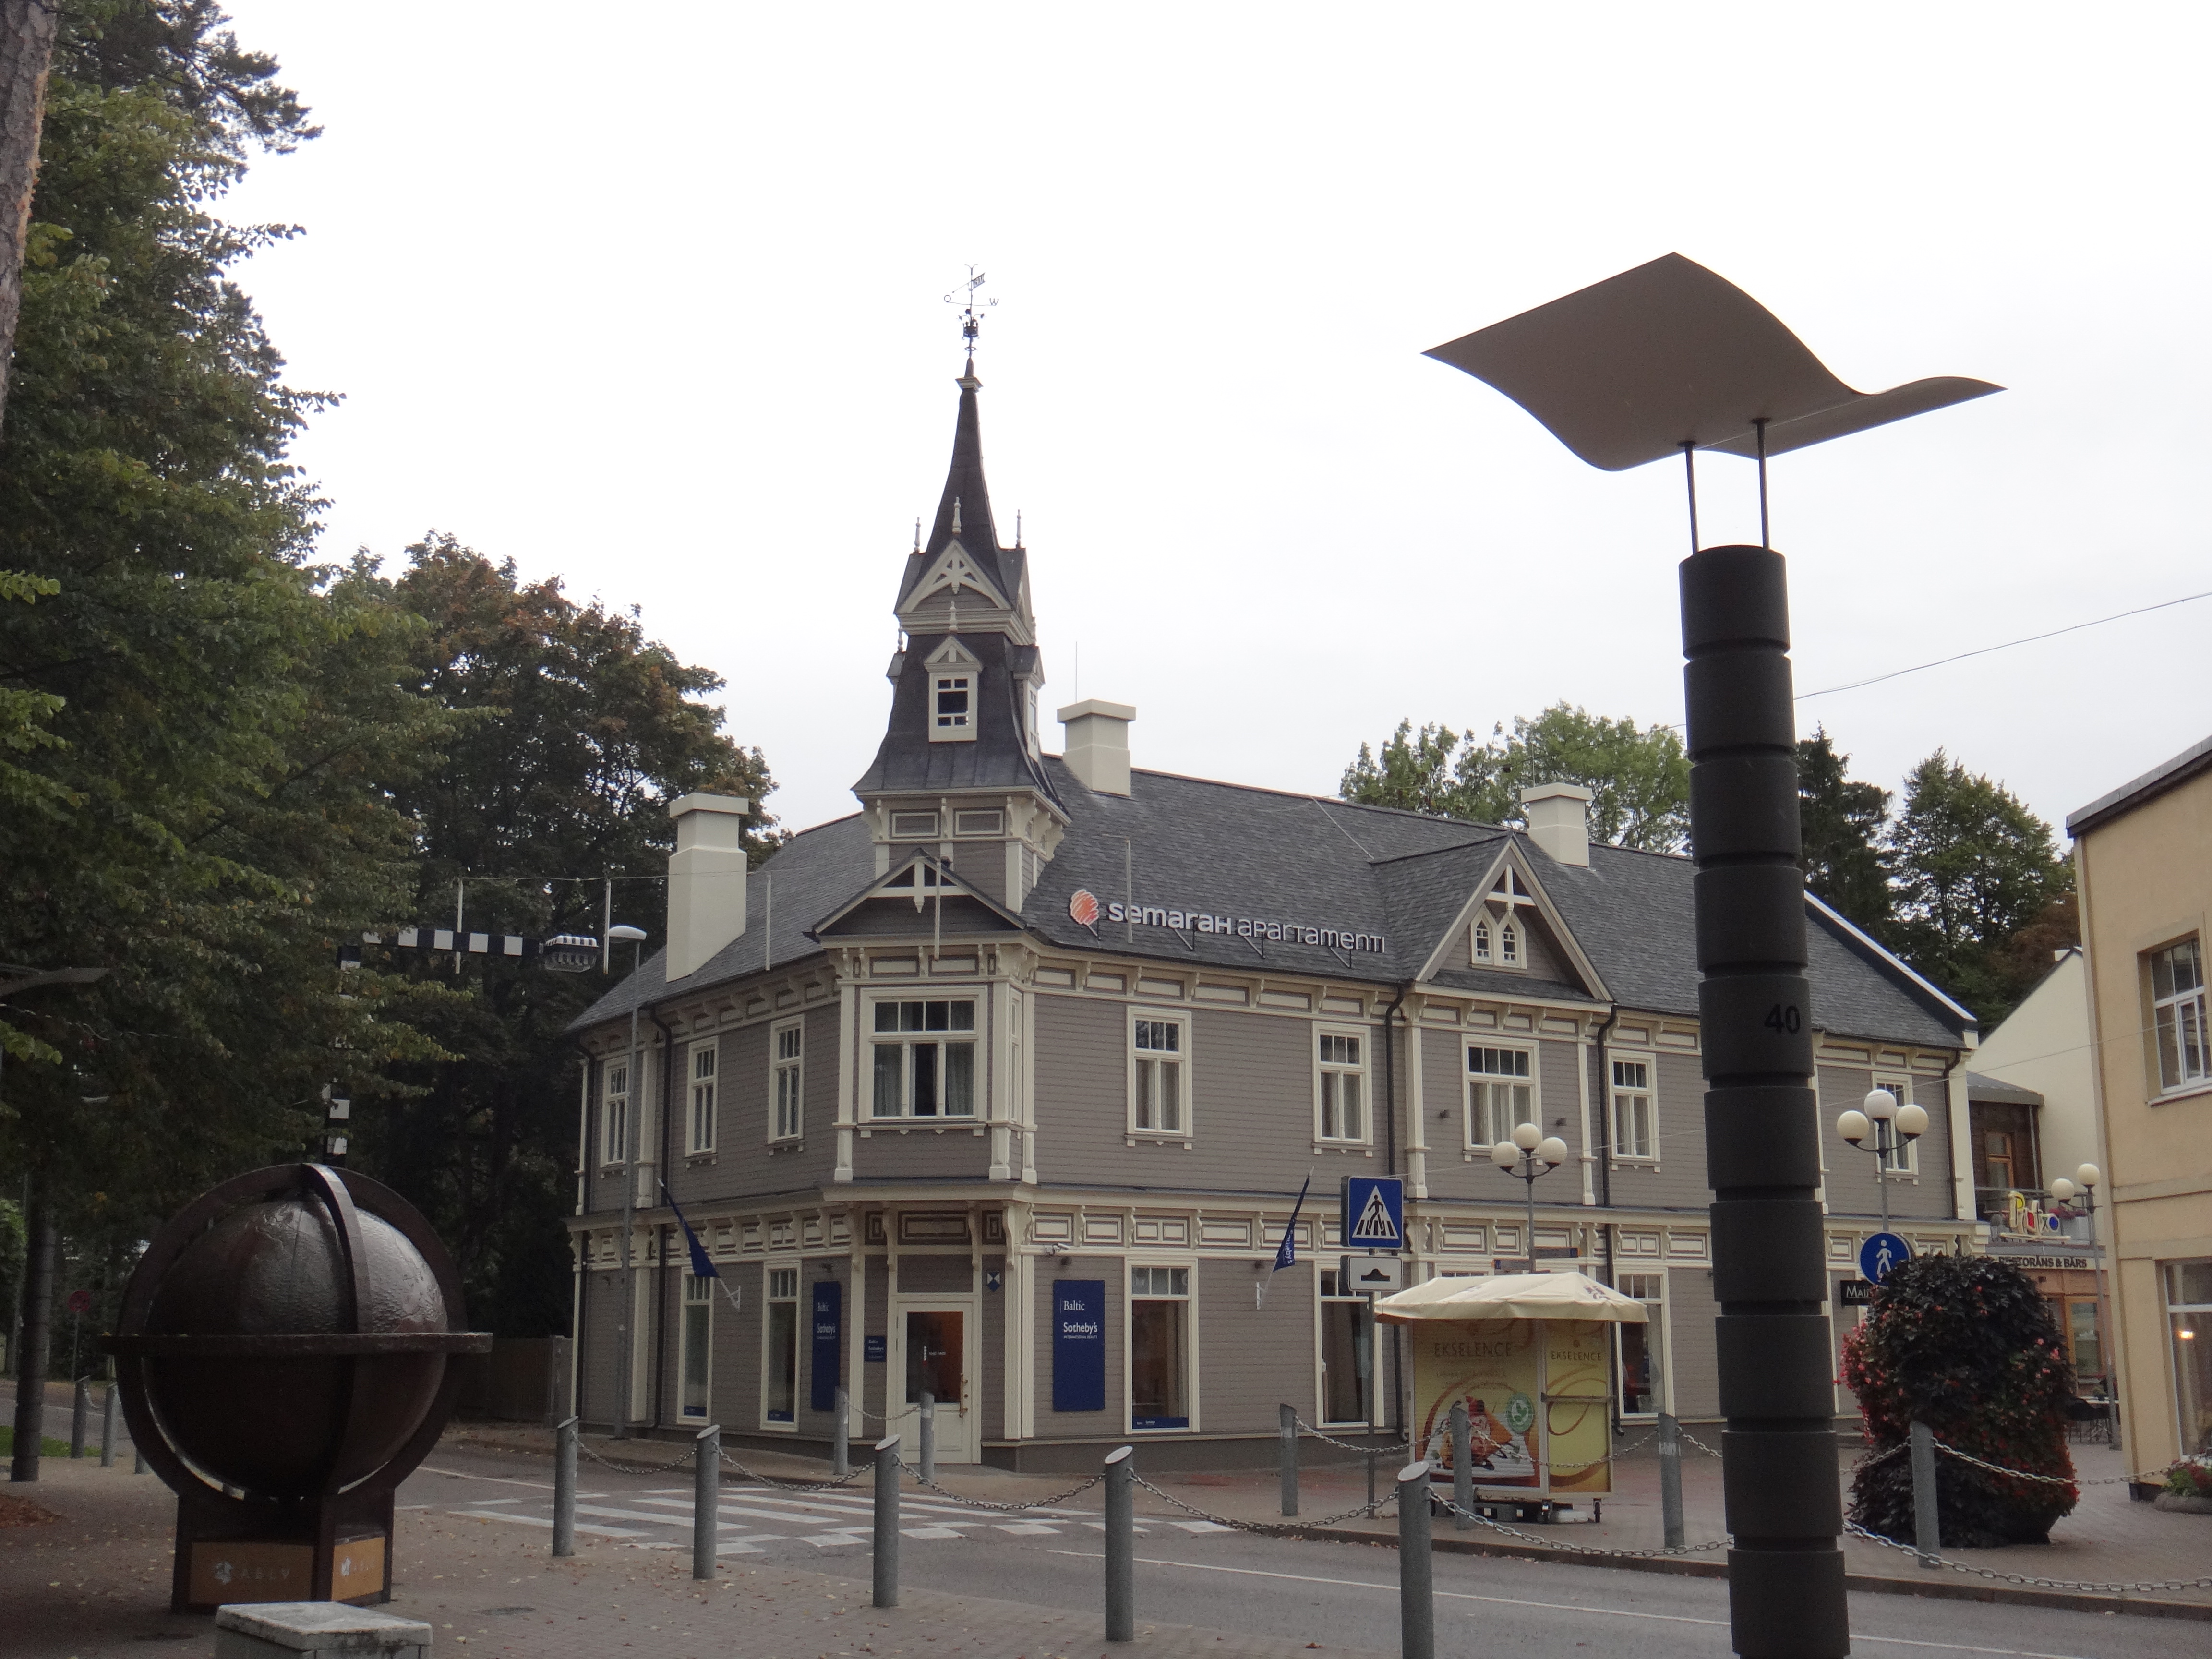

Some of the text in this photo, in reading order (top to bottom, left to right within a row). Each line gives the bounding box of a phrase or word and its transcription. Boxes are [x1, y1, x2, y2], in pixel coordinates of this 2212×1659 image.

[1765, 1004, 1800, 1034] 40
[1064, 1300, 1085, 1310] Baltic
[1063, 1322, 1098, 1335] Sotheby's
[1434, 1342, 1513, 1357] EKSELENCE
[1551, 1350, 1601, 1361] EKSELENCE
